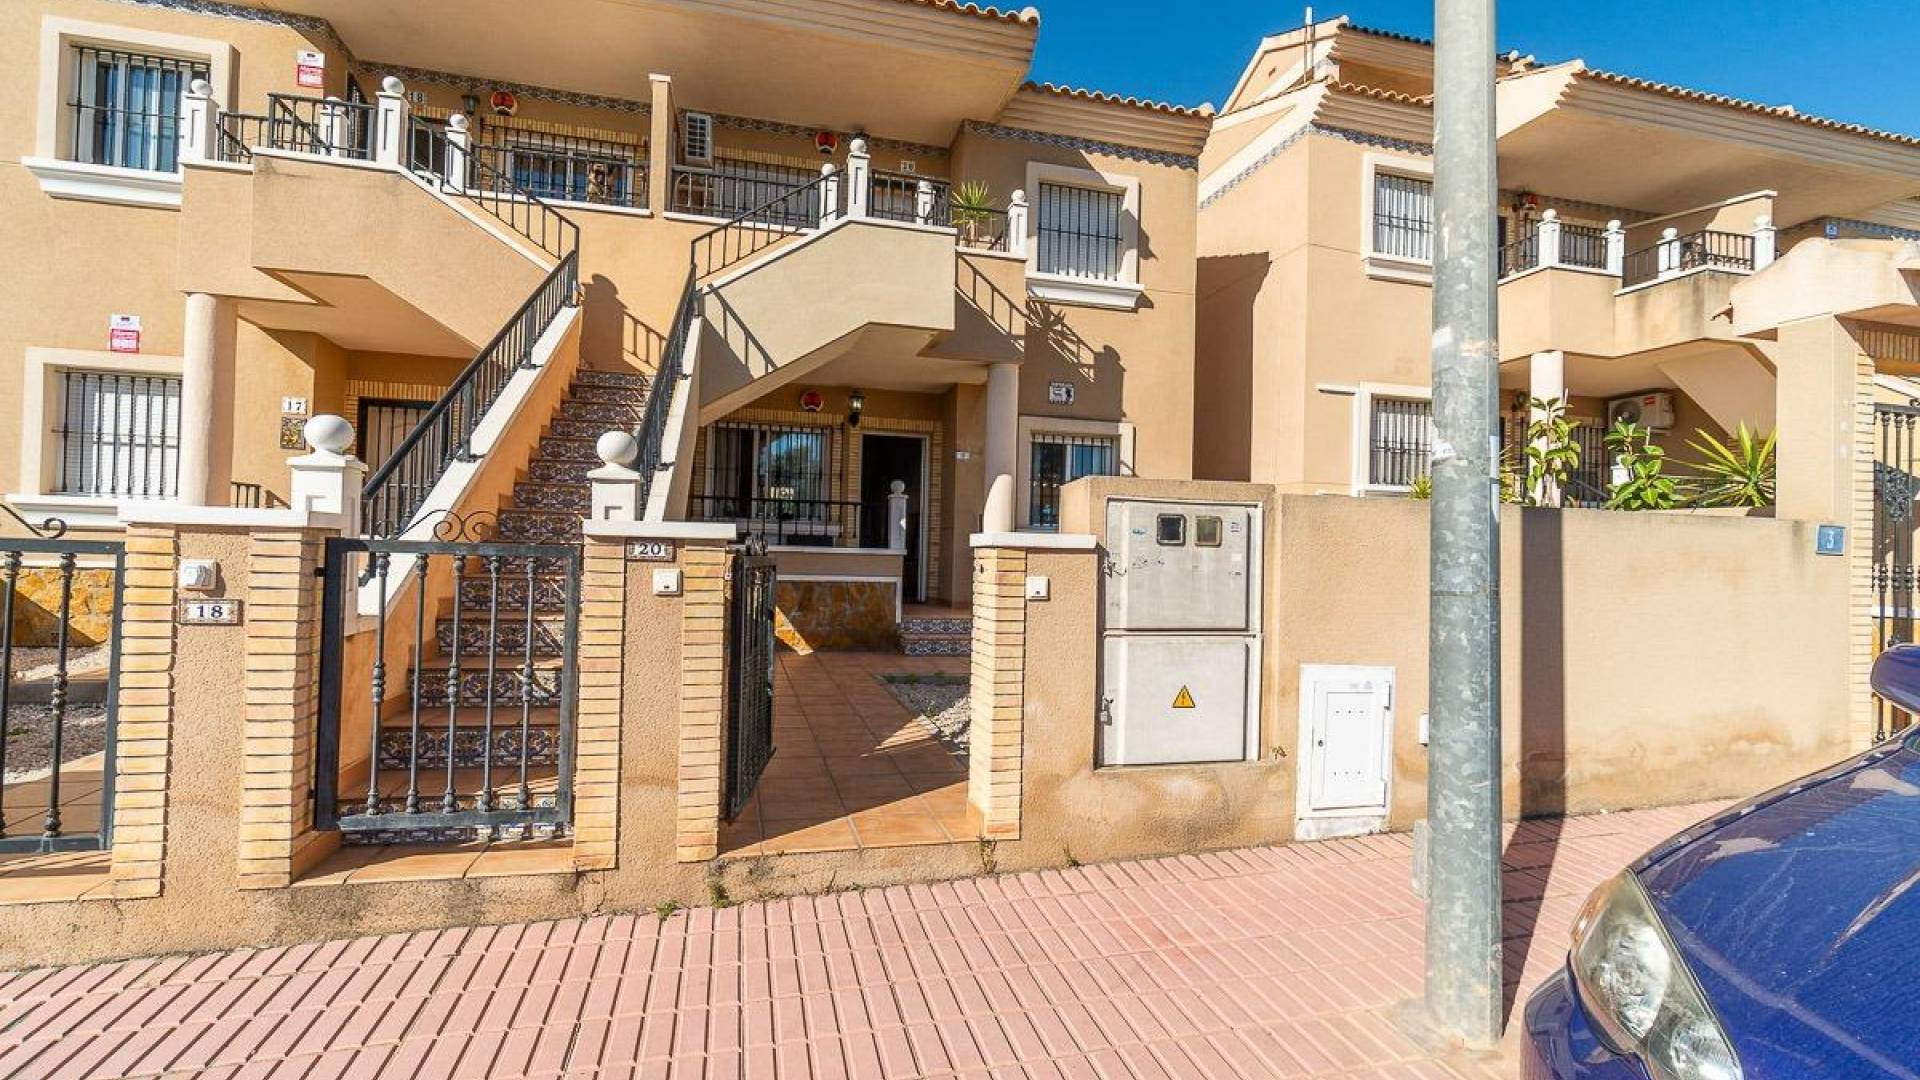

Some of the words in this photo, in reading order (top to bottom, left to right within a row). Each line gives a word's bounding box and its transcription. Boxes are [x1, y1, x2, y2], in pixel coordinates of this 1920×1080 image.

[410, 91, 423, 103] 18
[287, 400, 302, 411] 17
[1826, 530, 1835, 549] 3
[639, 543, 662, 556] 20
[196, 604, 223, 618] 18
